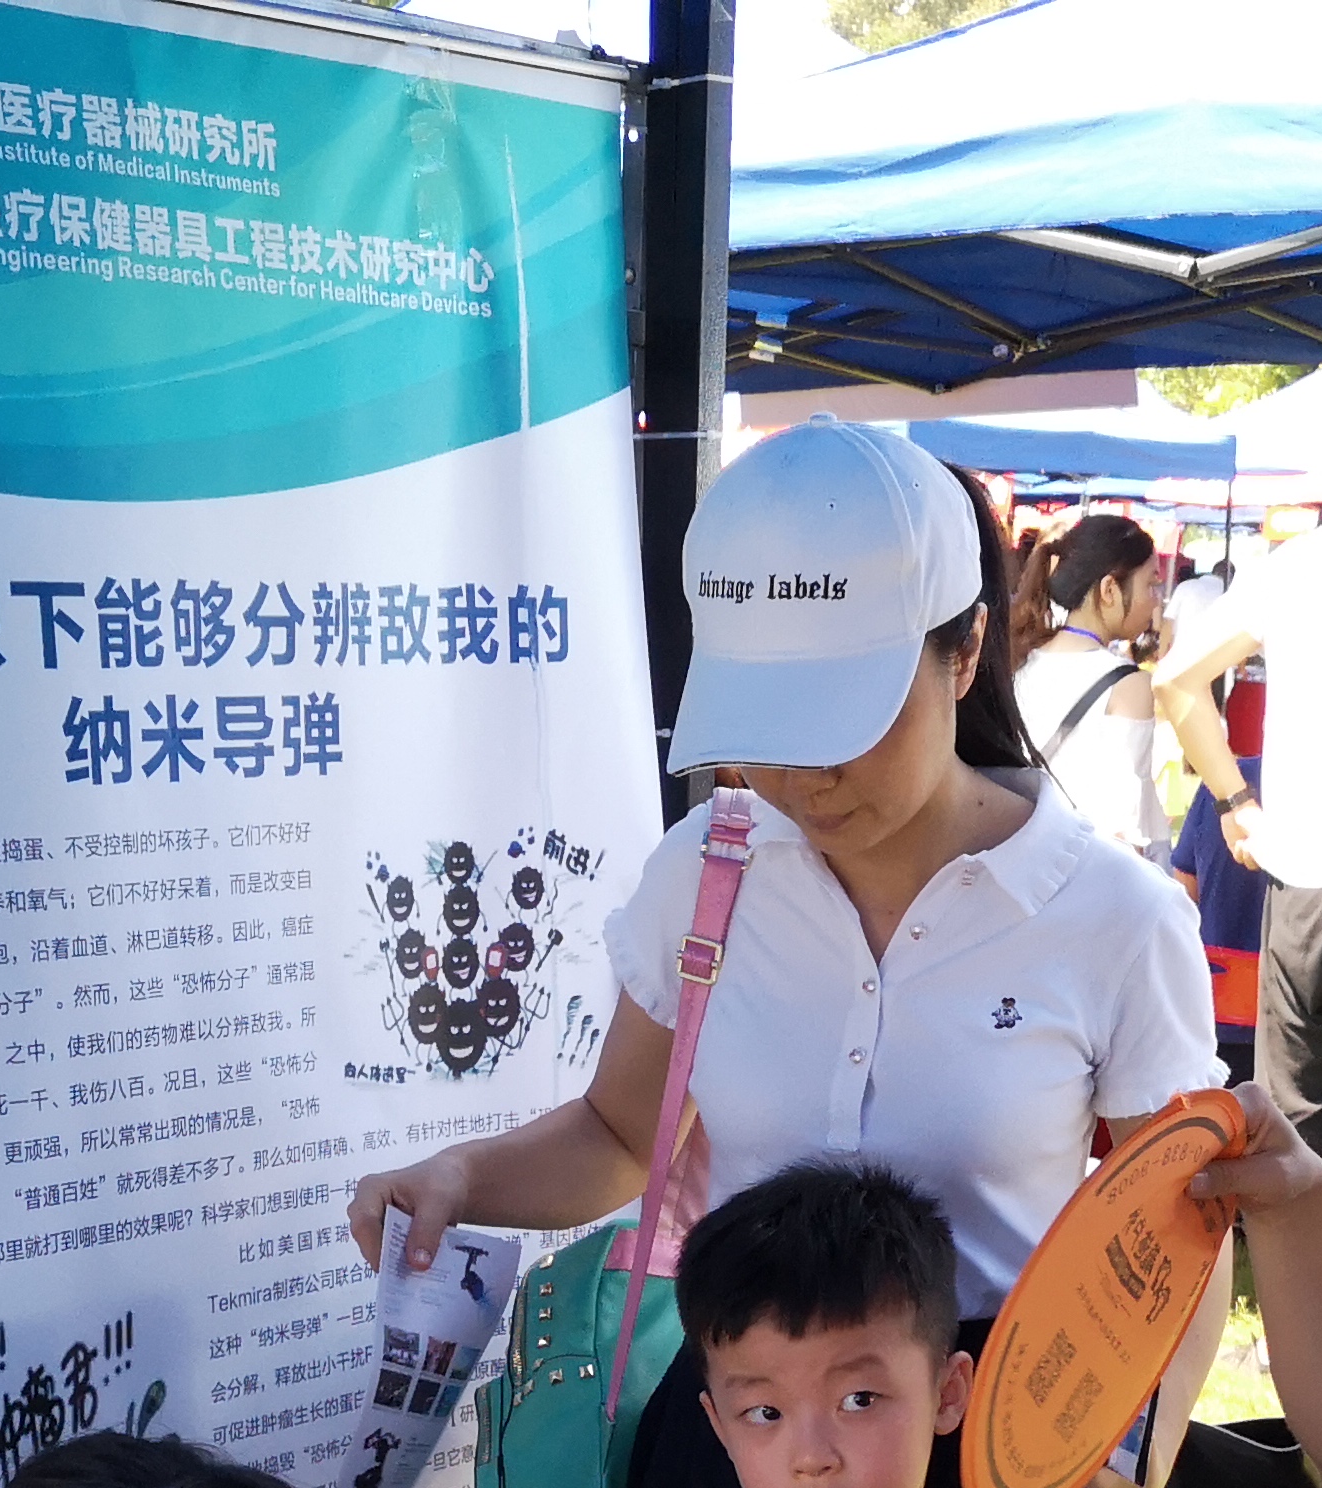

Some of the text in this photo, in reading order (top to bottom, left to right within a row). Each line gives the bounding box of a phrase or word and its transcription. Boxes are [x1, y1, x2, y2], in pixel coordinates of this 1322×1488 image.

[75, 153, 94, 172] of
[98, 154, 171, 180] Medical
[175, 165, 280, 197] Instruments
[118, 259, 217, 288] Research
[220, 270, 286, 294] Center
[287, 276, 316, 299] for
[320, 280, 418, 310] Healthcare
[422, 291, 493, 318] Devices
[767, 574, 848, 600] labels
[62, 692, 344, 785] 纳米导弹
